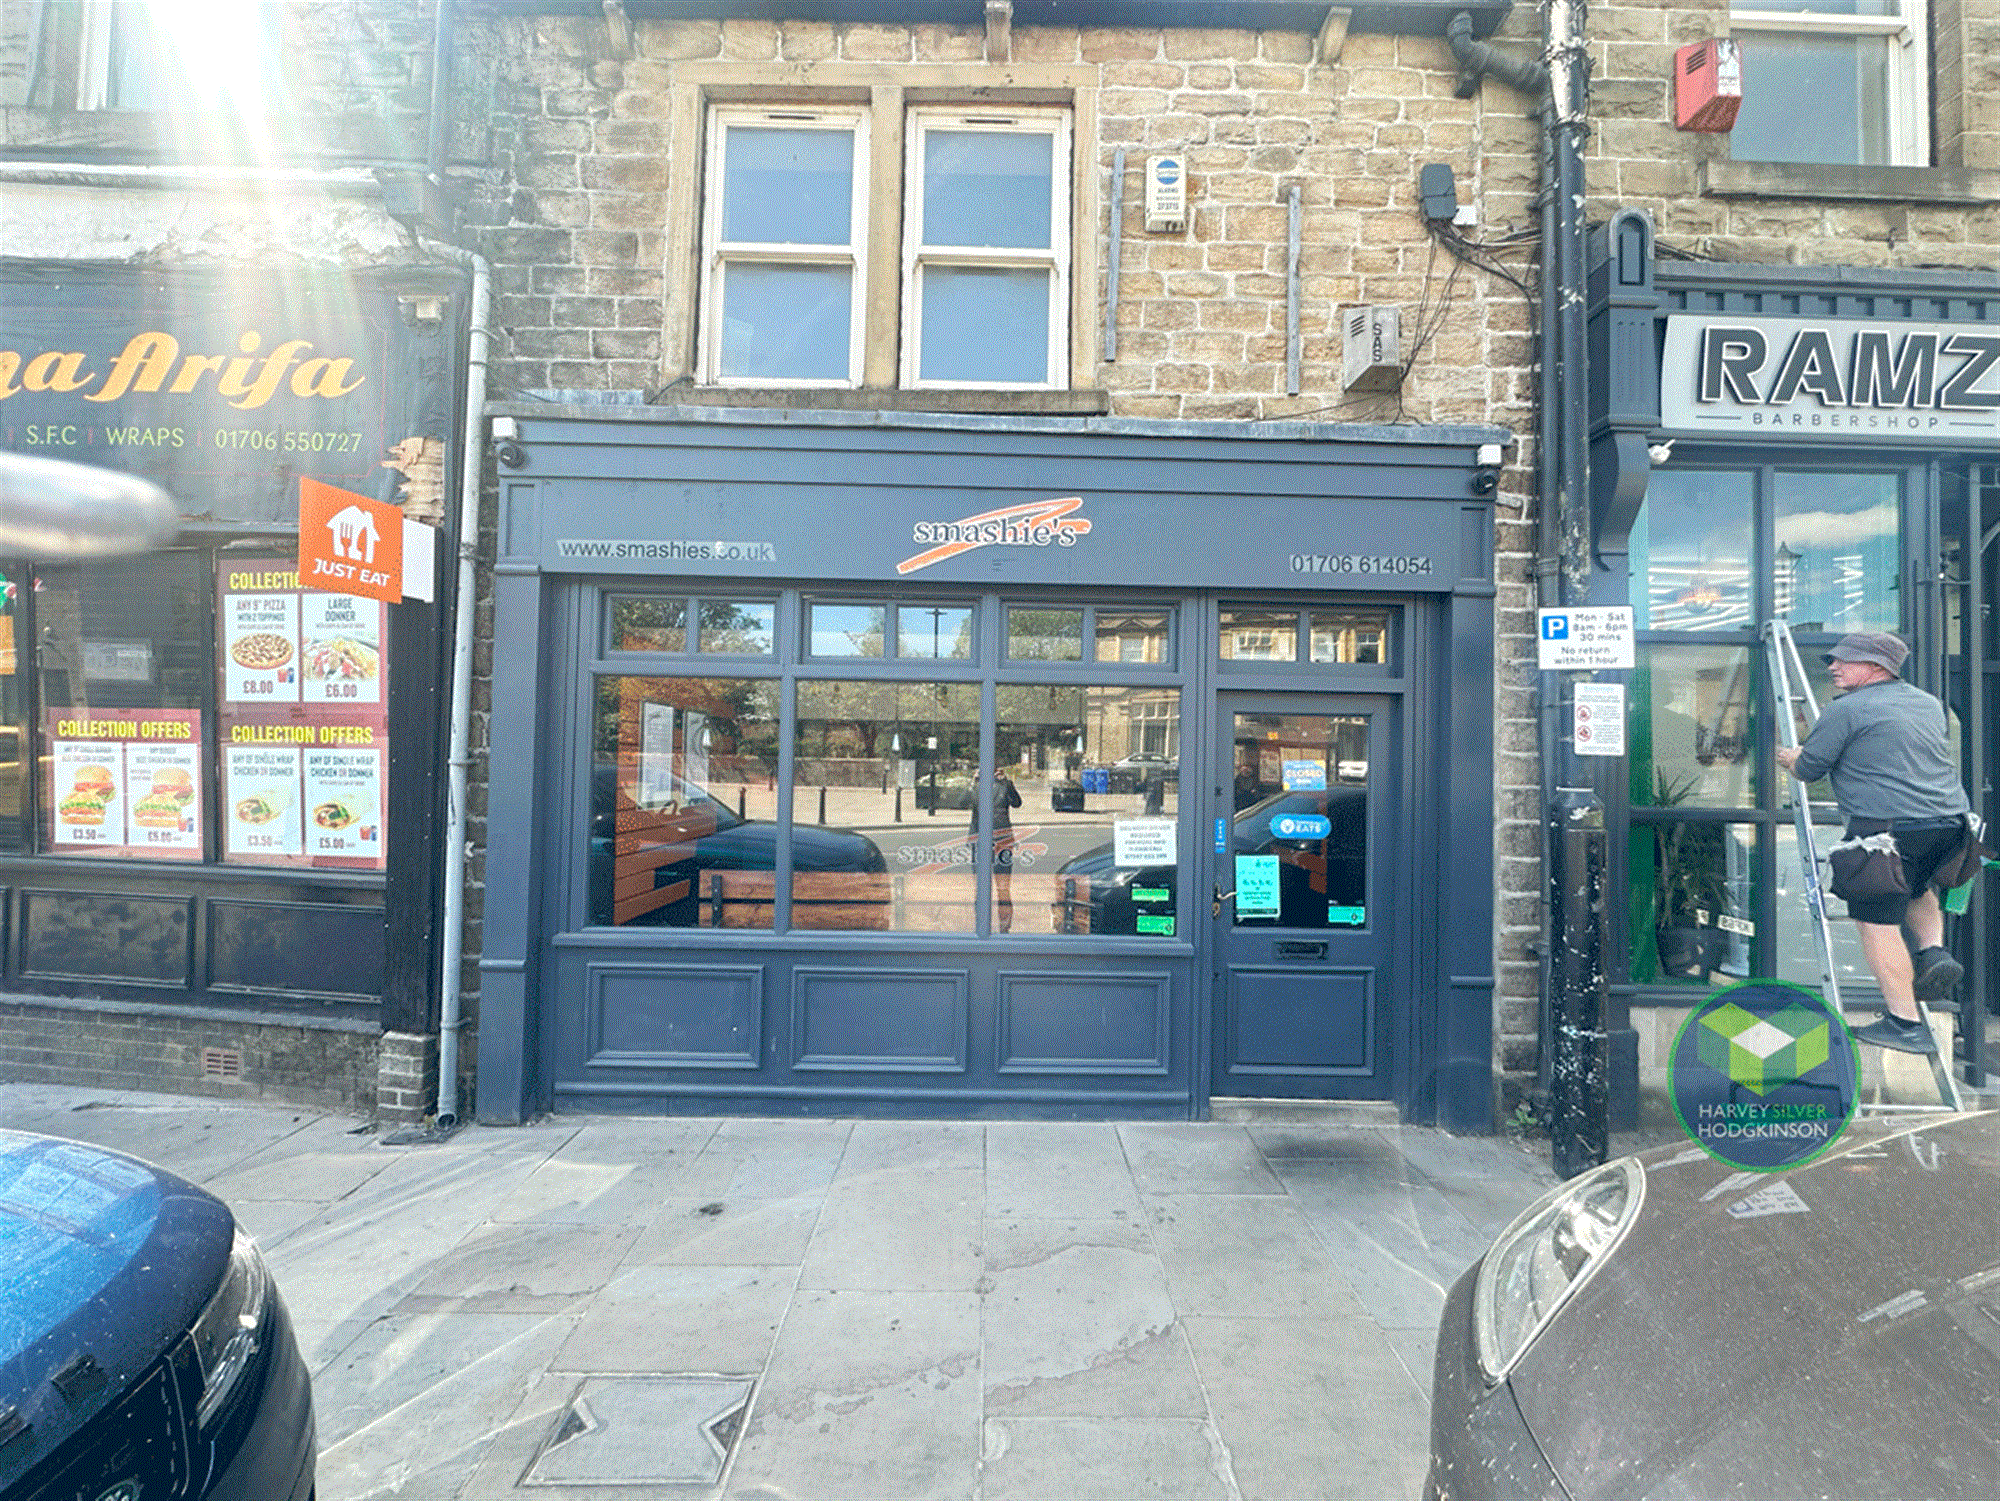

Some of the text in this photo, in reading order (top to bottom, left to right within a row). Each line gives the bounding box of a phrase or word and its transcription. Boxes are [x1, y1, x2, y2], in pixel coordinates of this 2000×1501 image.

[1373, 323, 1382, 362] SAS
[83, 330, 366, 410] Arifa
[1700, 325, 2000, 410] RAMZ
[1752, 413, 1939, 429] BARBERSHOP
[106, 426, 185, 448] WRAPS
[215, 429, 277, 451] 01706
[282, 431, 363, 453] 550727
[914, 518, 1077, 546] smashie's
[561, 541, 772, 560] www.smashies.co.uk
[1292, 555, 1431, 574] 01706 614054
[312, 558, 391, 587] JUST EAT
[263, 600, 286, 611] PIZZA
[328, 598, 353, 610] LARGE
[325, 611, 356, 622] DONNER
[1575, 613, 1597, 621] Mon
[1608, 612, 1625, 621] Sat
[1573, 623, 1595, 632] 8am
[1605, 623, 1628, 633] 6pm
[1579, 633, 1622, 642] 30 mins
[1561, 646, 1610, 654] No return
[1554, 656, 1585, 664] within
[1595, 656, 1618, 664] hour
[243, 680, 273, 694] £8.00
[325, 684, 357, 698] £6.00
[58, 720, 191, 739] COLLECTION OFFERS
[231, 725, 373, 744] COLLECTION OFFERS
[311, 768, 338, 778] CHICKEN
[319, 838, 344, 849] £5.00
